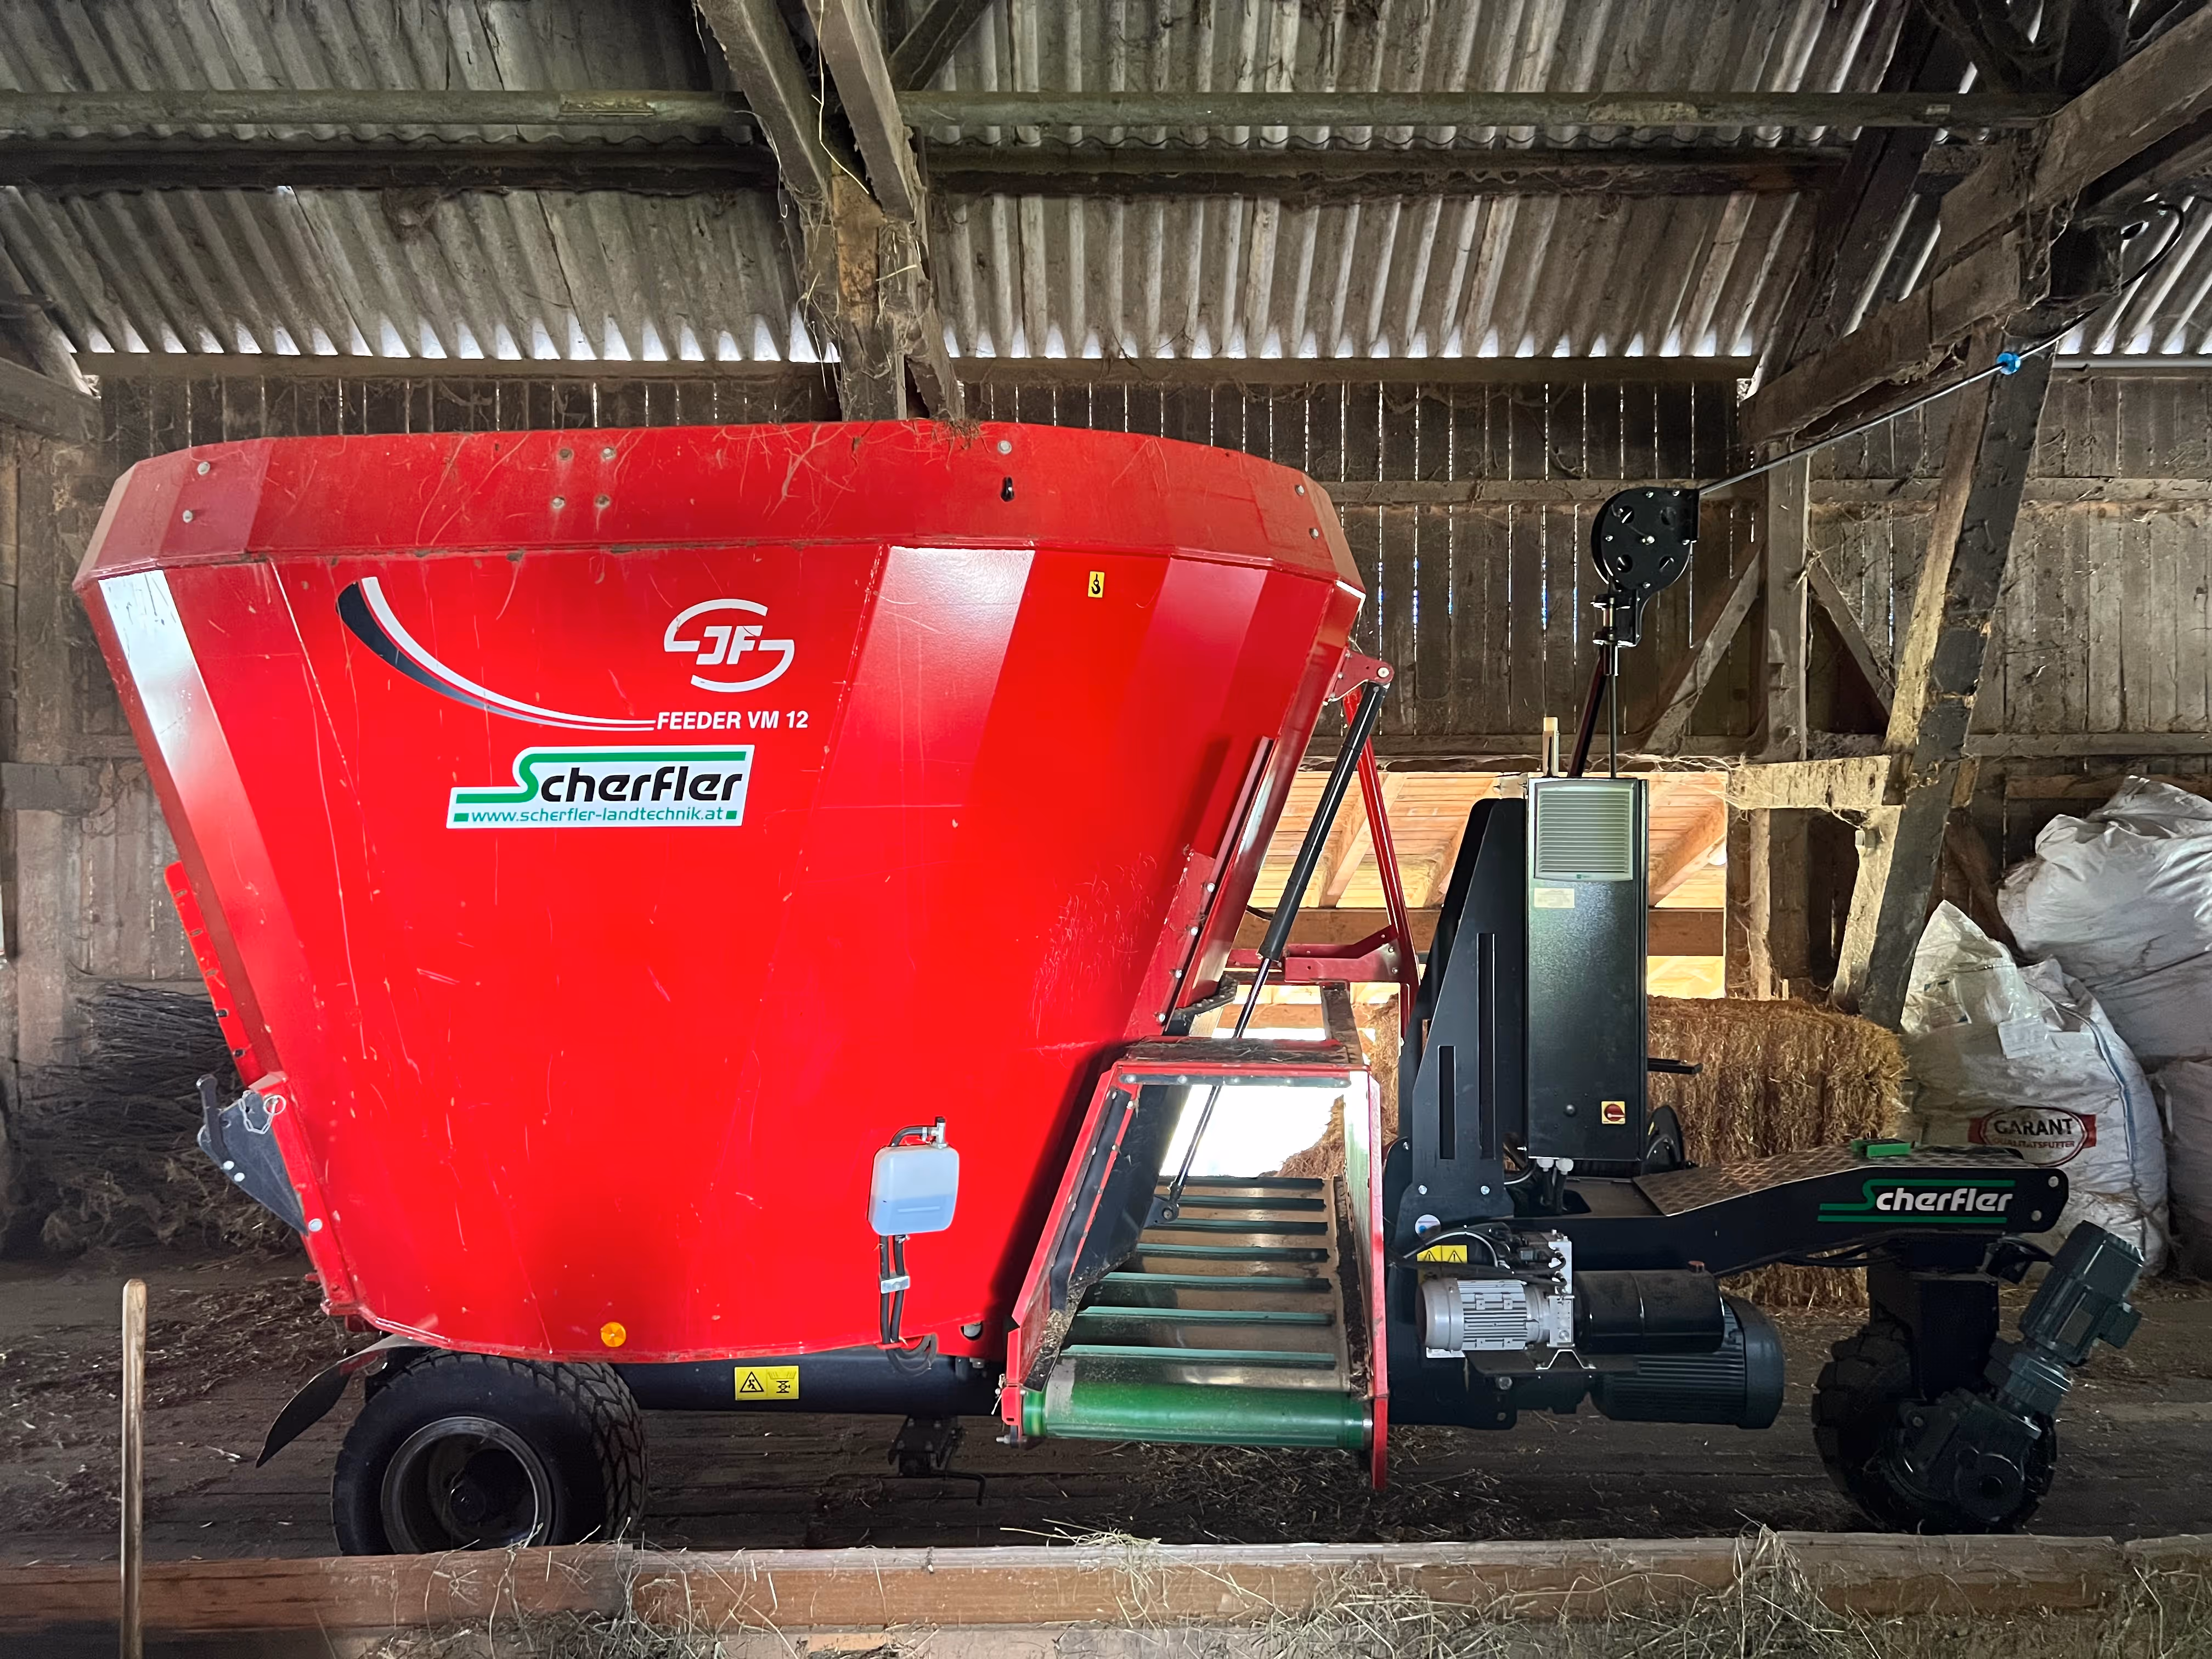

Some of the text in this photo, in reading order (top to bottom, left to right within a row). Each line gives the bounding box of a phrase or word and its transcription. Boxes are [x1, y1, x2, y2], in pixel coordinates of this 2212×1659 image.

[657, 710, 809, 730] FEEDER VM 12
[516, 751, 743, 804] Scherfler
[471, 807, 724, 822] www.scherfler-landtechnik.at
[1994, 1118, 2073, 1136] GARANT
[1863, 1179, 2013, 1211] Scherfler
